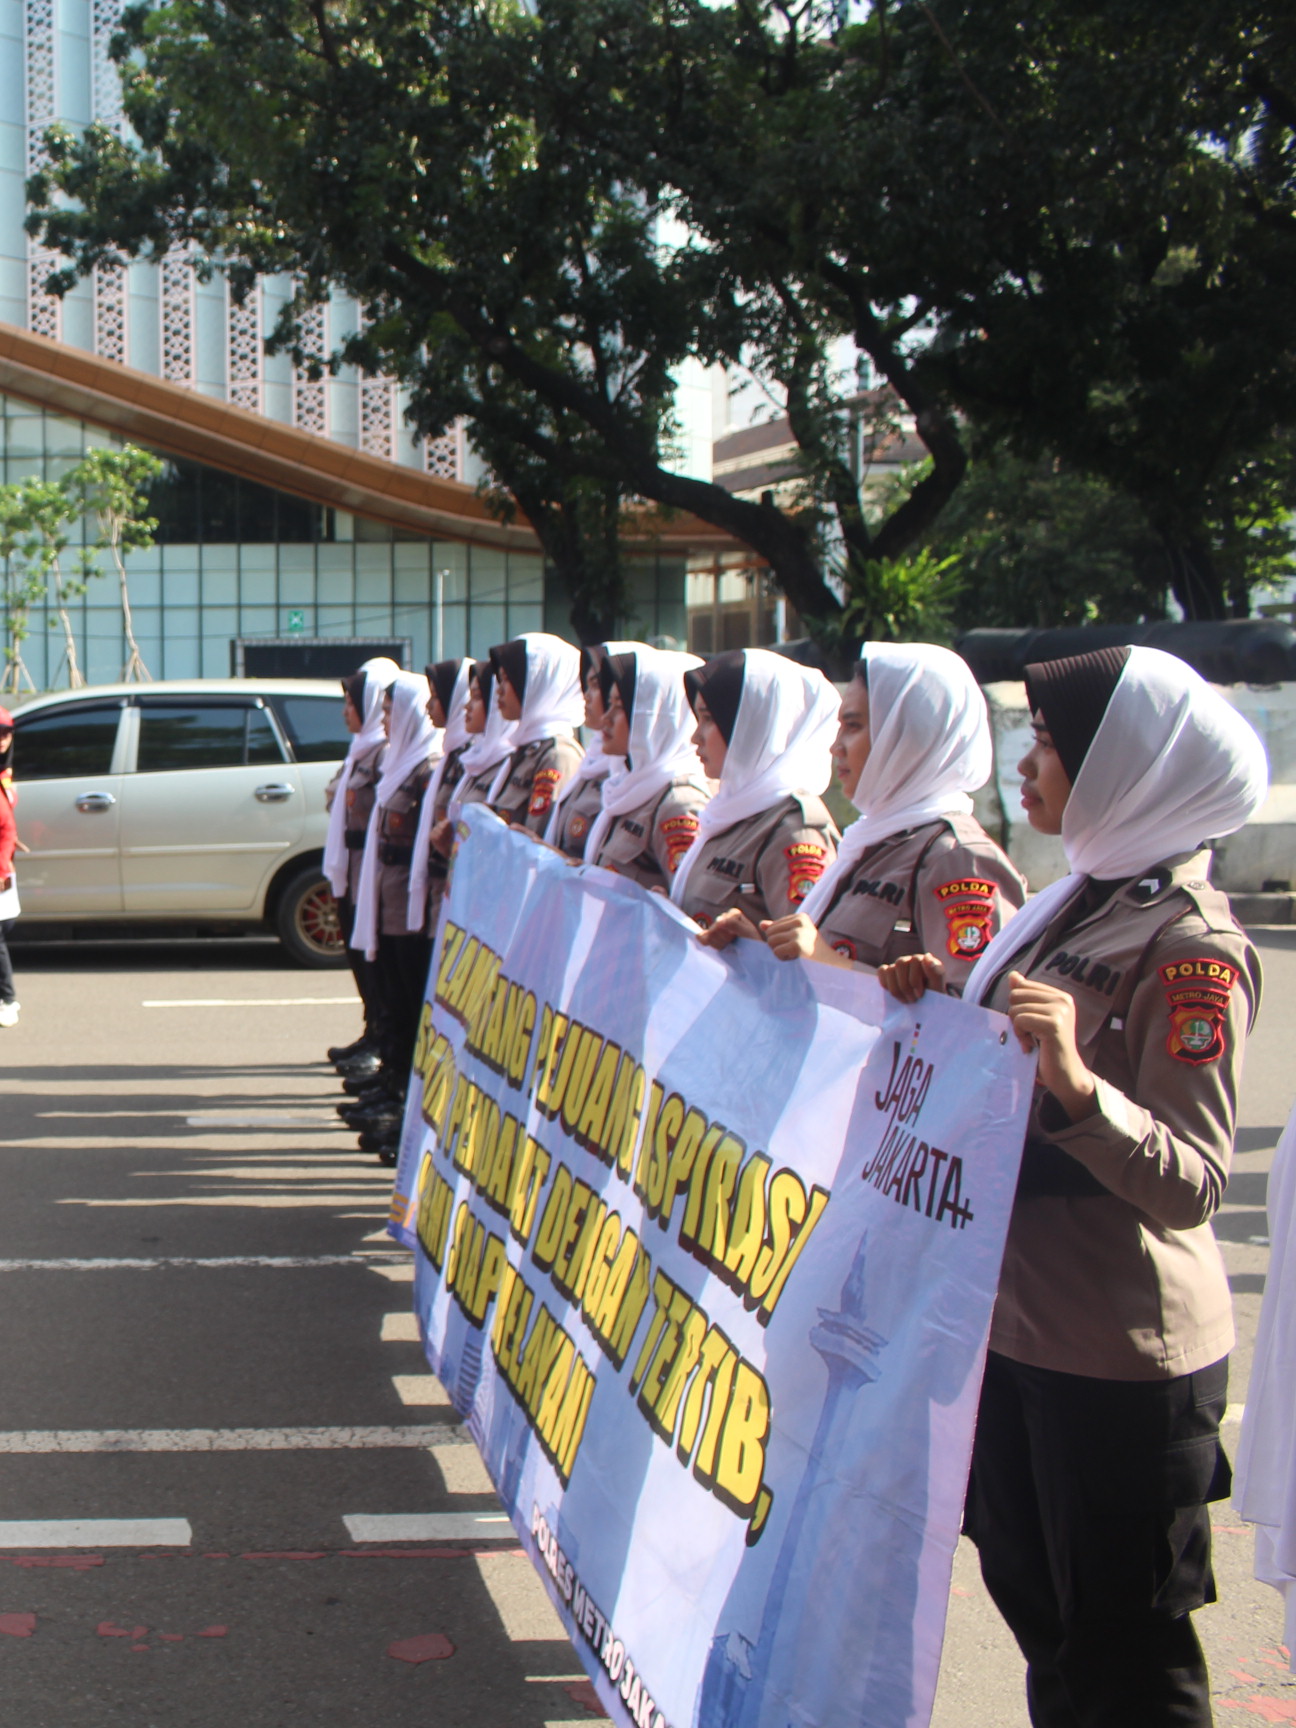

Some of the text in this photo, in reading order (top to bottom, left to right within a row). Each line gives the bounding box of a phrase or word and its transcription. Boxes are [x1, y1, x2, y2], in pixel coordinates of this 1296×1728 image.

[790, 845, 822, 856] POLDA
[853, 880, 906, 906] POLRI
[940, 882, 990, 897] POLDA
[1045, 951, 1121, 996] POLRI
[1165, 962, 1232, 983] POLDA
[1172, 991, 1224, 1004] METRO JAYA
[528, 1001, 646, 1181] PEJUANG
[875, 1041, 934, 1128] JAGA
[531, 1161, 651, 1374] DENGAN
[572, 1577, 626, 1688] METRO
